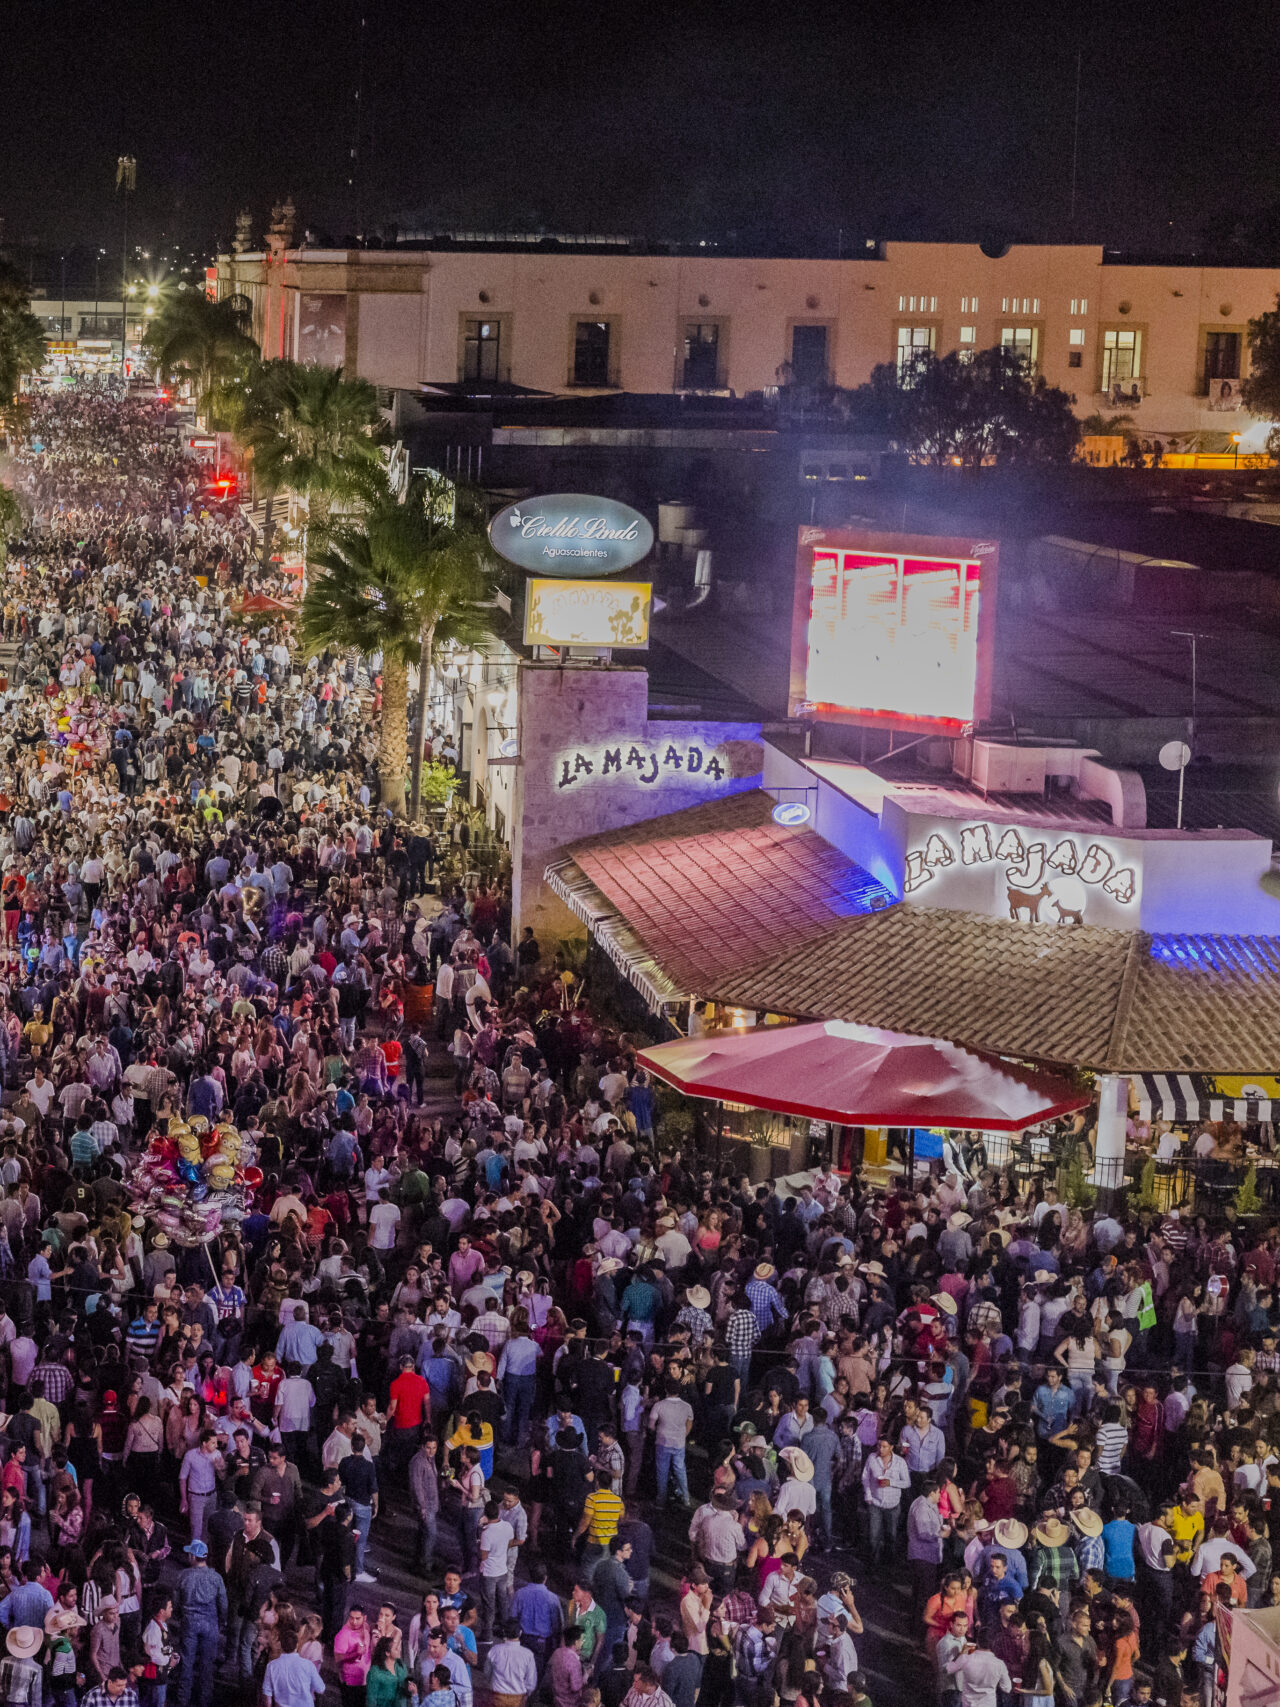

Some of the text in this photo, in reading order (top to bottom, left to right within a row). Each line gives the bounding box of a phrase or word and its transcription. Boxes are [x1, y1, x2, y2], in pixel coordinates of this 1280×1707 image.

[521, 516, 639, 540] Cielito Lindo
[543, 545, 608, 558] Aguascalientes
[558, 745, 725, 789] LA MAJADA
[903, 823, 1135, 904] LA MAJADA
[77, 1187, 85, 1198] 9
